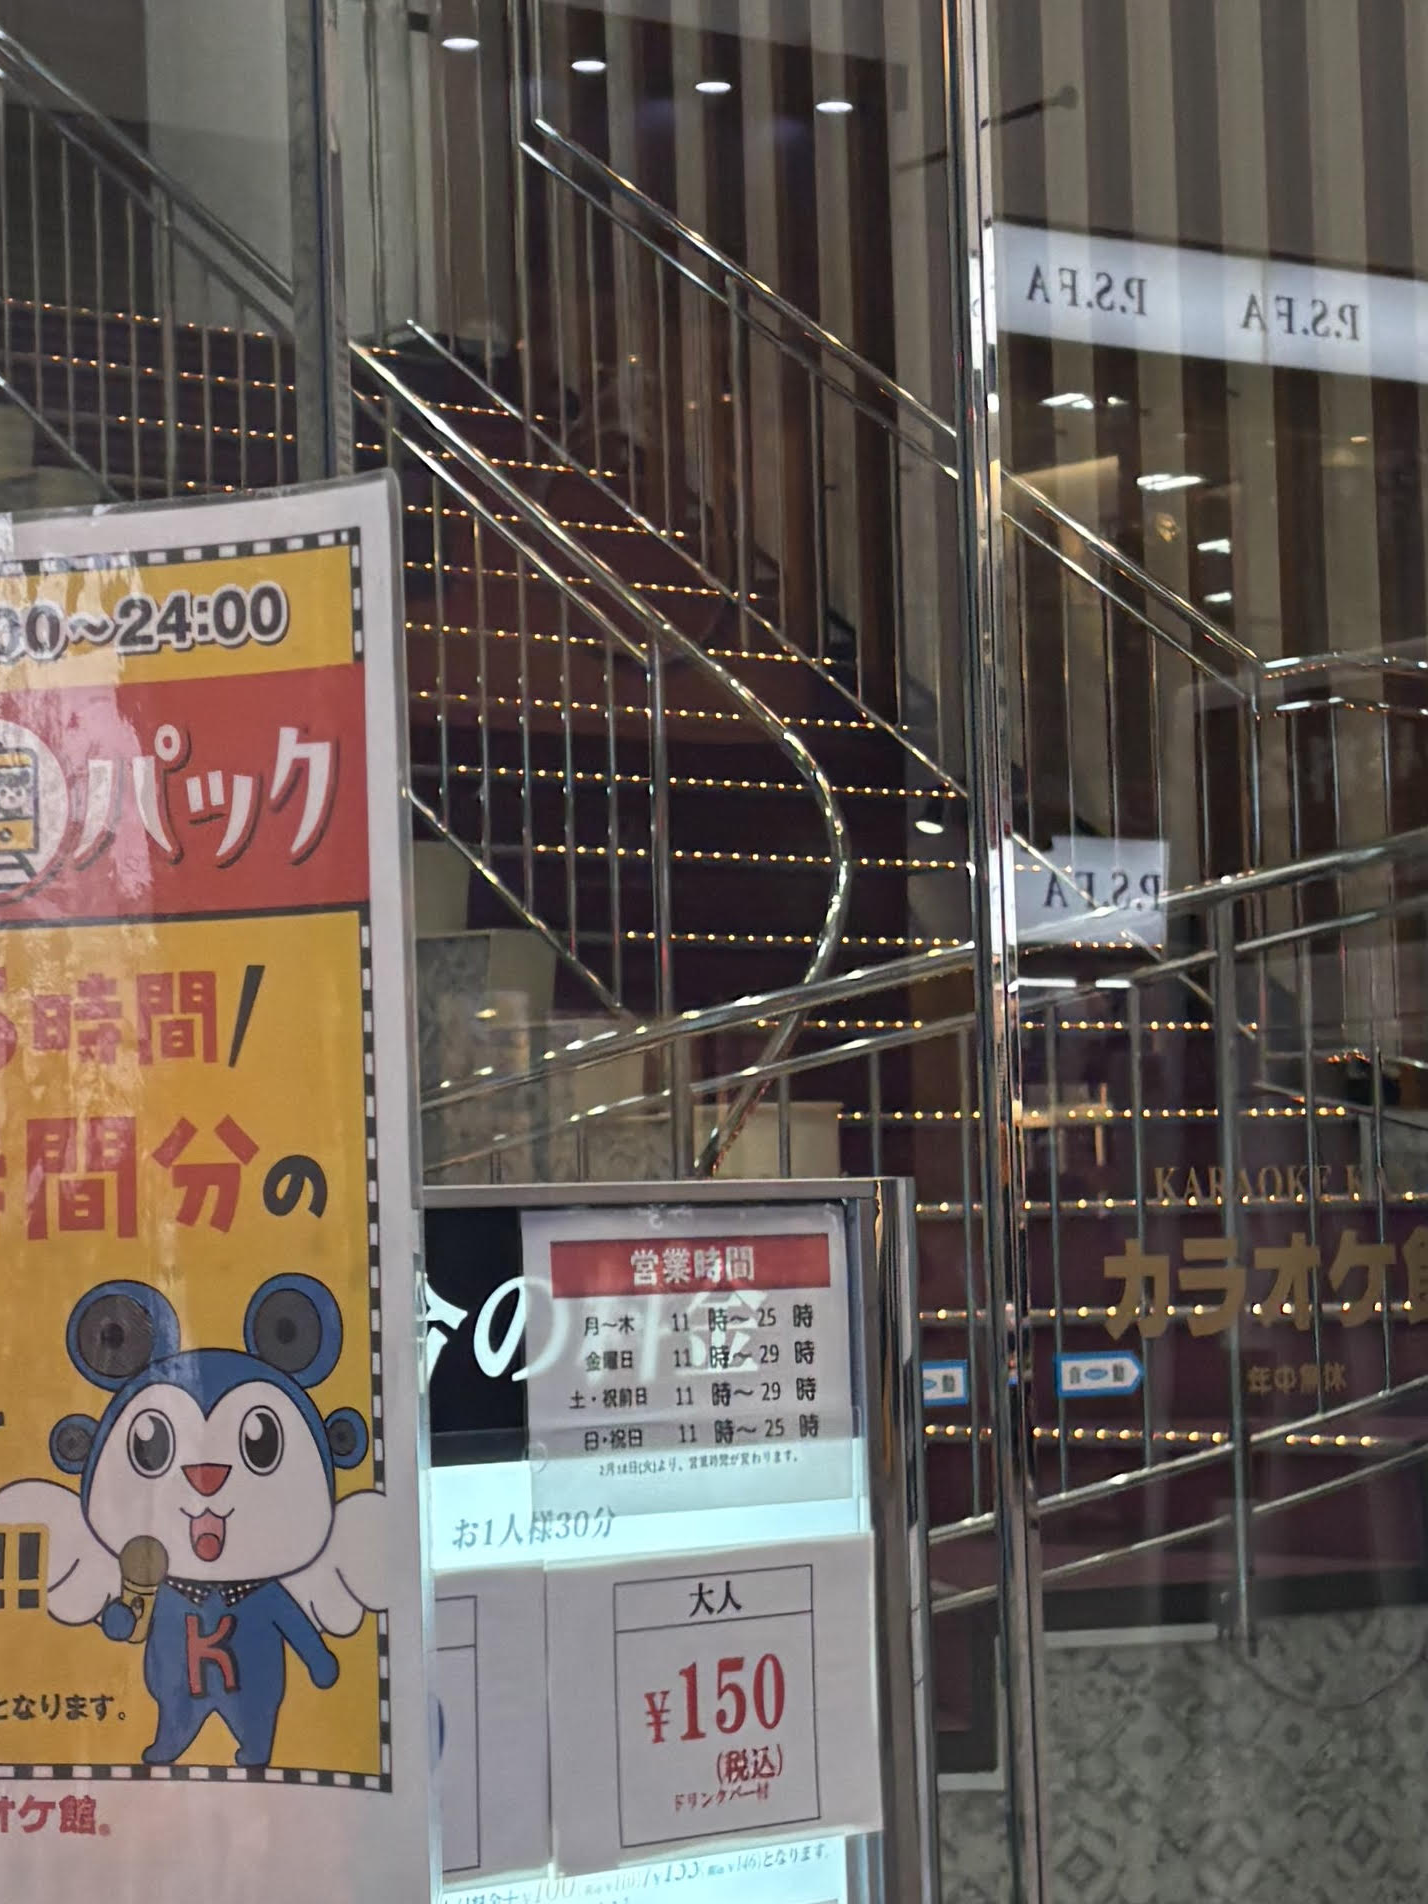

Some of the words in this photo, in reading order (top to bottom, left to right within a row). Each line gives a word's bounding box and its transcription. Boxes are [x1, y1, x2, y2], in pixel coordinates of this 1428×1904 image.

[72, 723, 342, 866] パック
[630, 1245, 755, 1286] 営業時間
[672, 1312, 690, 1333] 11
[585, 1350, 634, 1372] 金曜日
[673, 1348, 692, 1368] 11
[676, 1386, 694, 1406] 11
[679, 1424, 698, 1444] 11
[452, 1506, 617, 1550] お1人様30分
[688, 1579, 743, 1618] 大人
[184, 1612, 240, 1695] K
[644, 1652, 786, 1745] ¥150
[716, 1743, 784, 1785] (税込)
